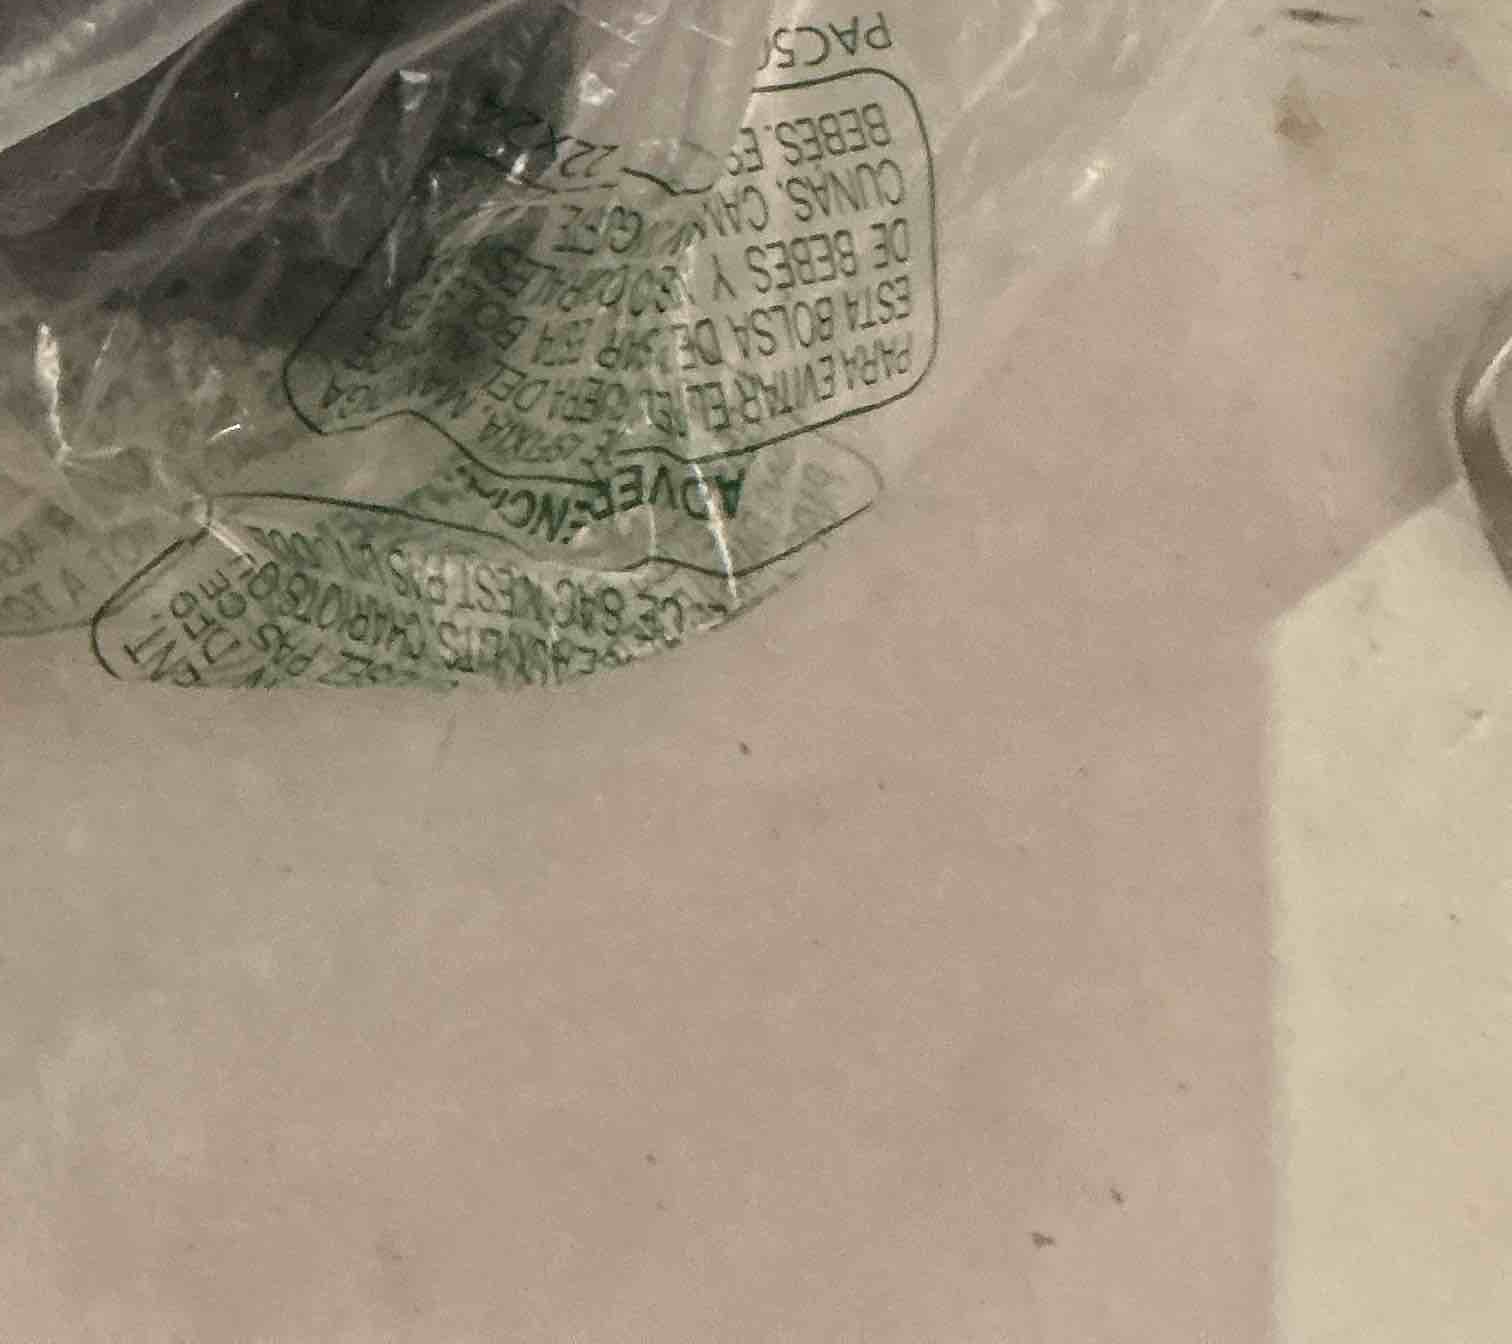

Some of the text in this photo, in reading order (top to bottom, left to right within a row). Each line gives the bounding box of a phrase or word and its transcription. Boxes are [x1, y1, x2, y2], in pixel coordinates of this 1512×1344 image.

[744, 228, 858, 294] BEBES
[872, 217, 911, 270] DE
[725, 296, 835, 362] BOLSA
[844, 275, 911, 332] ESTA
